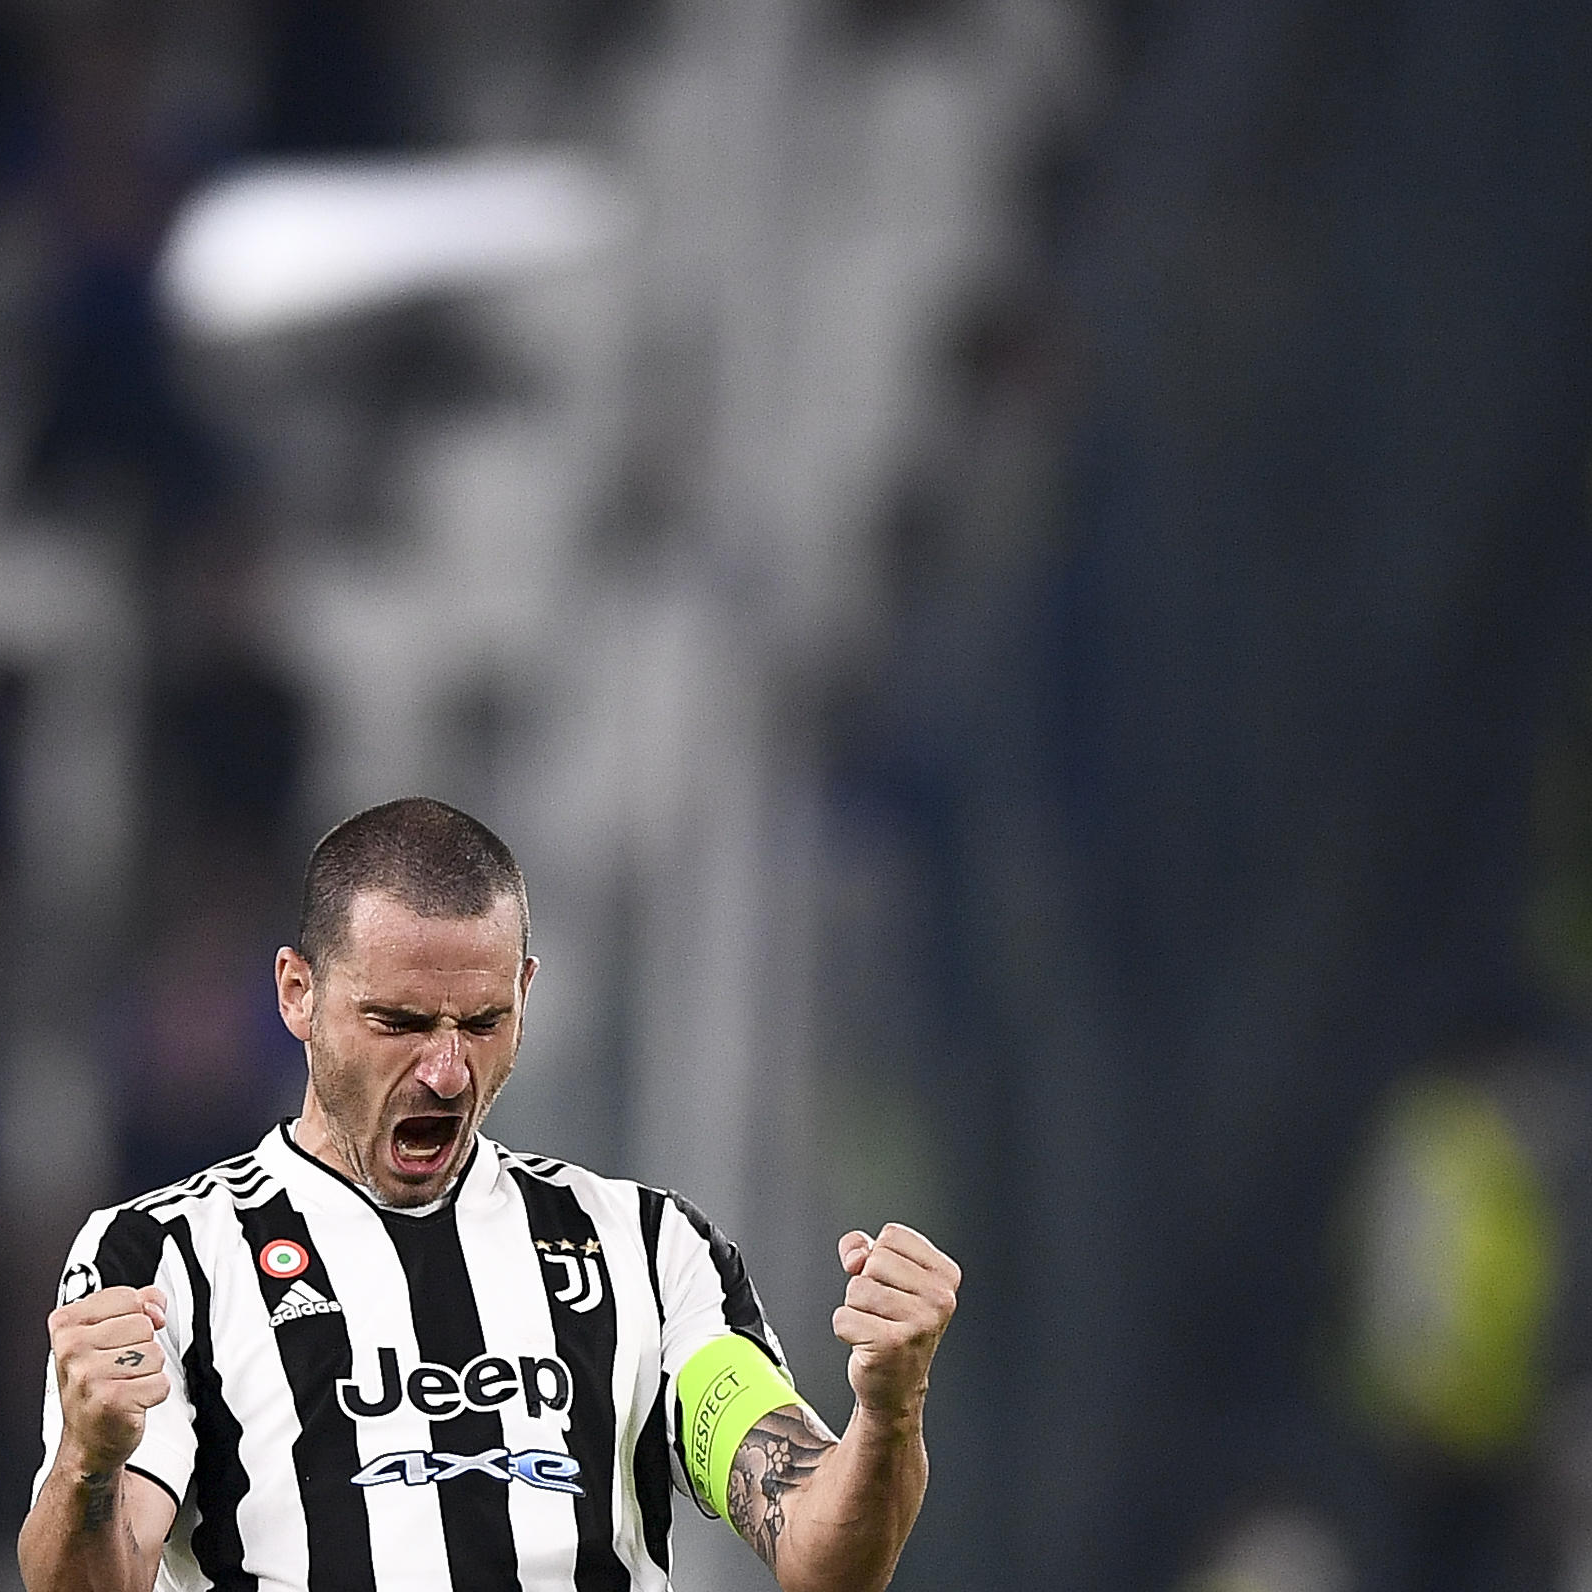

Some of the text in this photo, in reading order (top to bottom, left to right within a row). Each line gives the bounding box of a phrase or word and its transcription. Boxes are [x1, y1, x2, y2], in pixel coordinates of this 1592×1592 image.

[269, 1300, 343, 1328] adidas
[337, 1346, 575, 1426] Jeep
[694, 1370, 741, 1471] RESPECT
